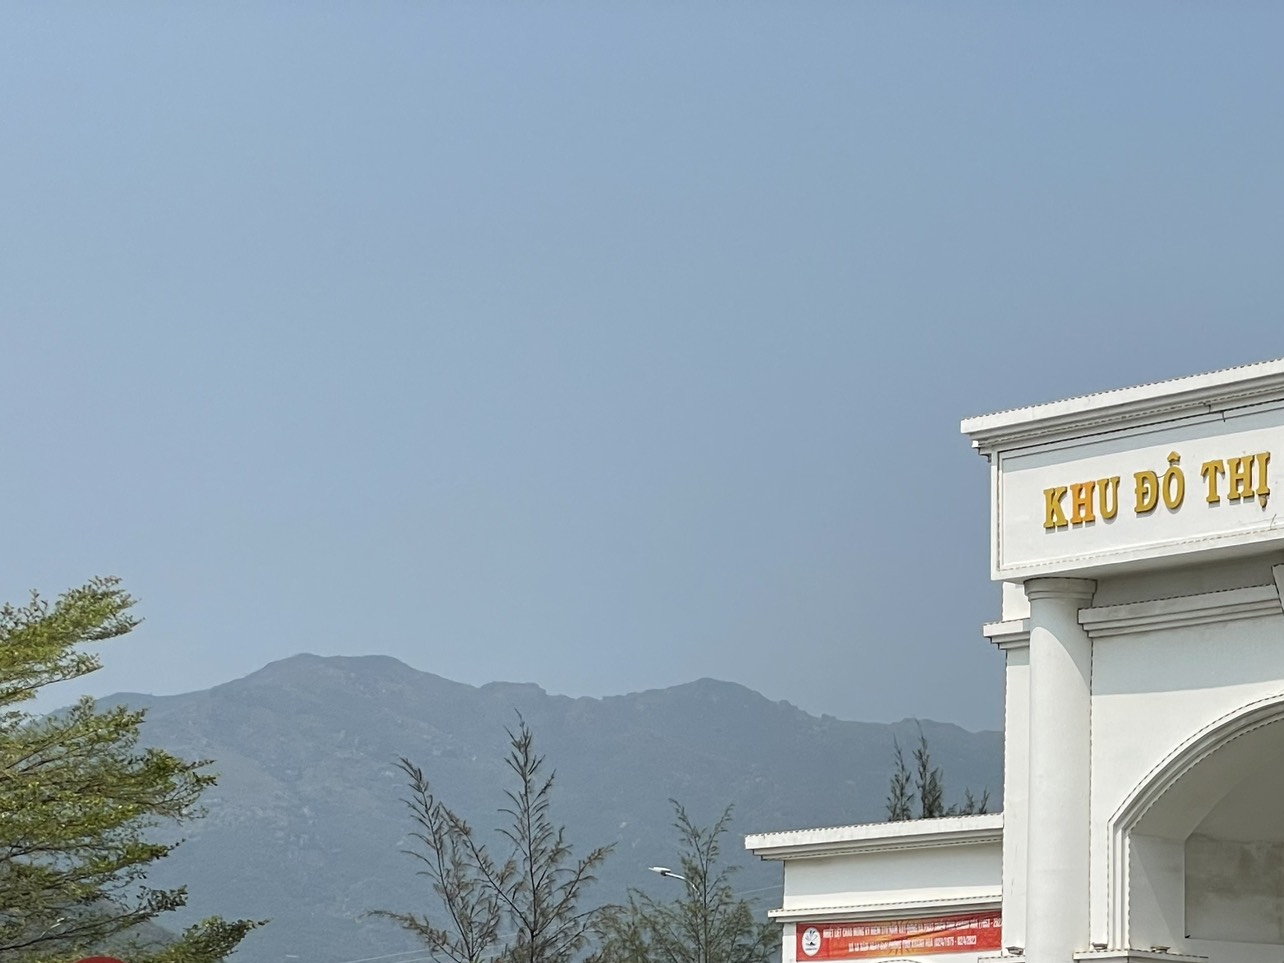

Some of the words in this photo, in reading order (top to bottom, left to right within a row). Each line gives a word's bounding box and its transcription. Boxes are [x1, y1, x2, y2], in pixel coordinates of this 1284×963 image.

[1043, 481, 1119, 529] KHU
[1133, 450, 1186, 514] ĐÔ
[1200, 451, 1272, 508] THỊ
